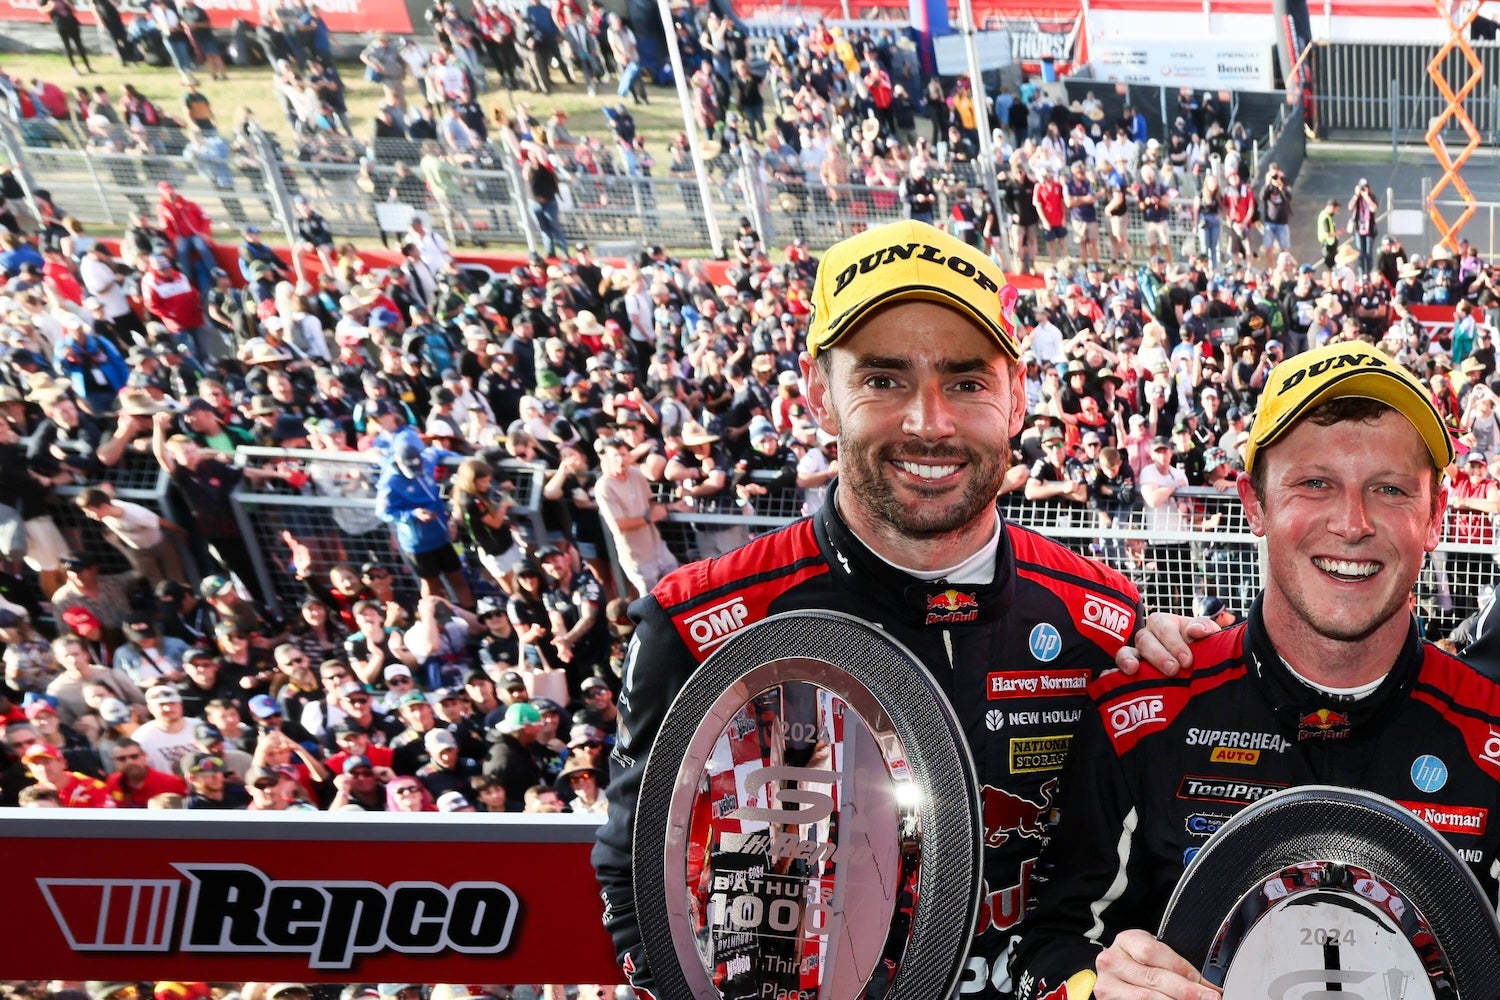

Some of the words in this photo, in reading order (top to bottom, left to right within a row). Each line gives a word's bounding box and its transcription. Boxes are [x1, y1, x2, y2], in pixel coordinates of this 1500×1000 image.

[1217, 63, 1260, 74] Bendix
[833, 243, 999, 297] DUNLOP
[690, 603, 749, 643] OMP
[925, 612, 950, 626] Red
[950, 608, 978, 624] Bull
[1084, 603, 1128, 633] OMP
[1035, 629, 1057, 653] hp
[991, 675, 1039, 694] Harvey
[1041, 674, 1086, 691] Norman
[1009, 711, 1039, 726] NEW
[1041, 710, 1082, 724] HOLLA
[1110, 699, 1165, 733] OMP
[780, 722, 830, 743] 2024
[1013, 738, 1073, 754] NATIONA
[1215, 749, 1255, 762] AUTO
[1016, 753, 1067, 768] STORAG
[1417, 757, 1441, 786] hp
[1425, 808, 1481, 829] Norman
[714, 876, 834, 901] BATHURS
[171, 862, 519, 969] Repco
[710, 893, 834, 936] 1000
[1300, 927, 1357, 947] 2024
[764, 954, 812, 977] Third
